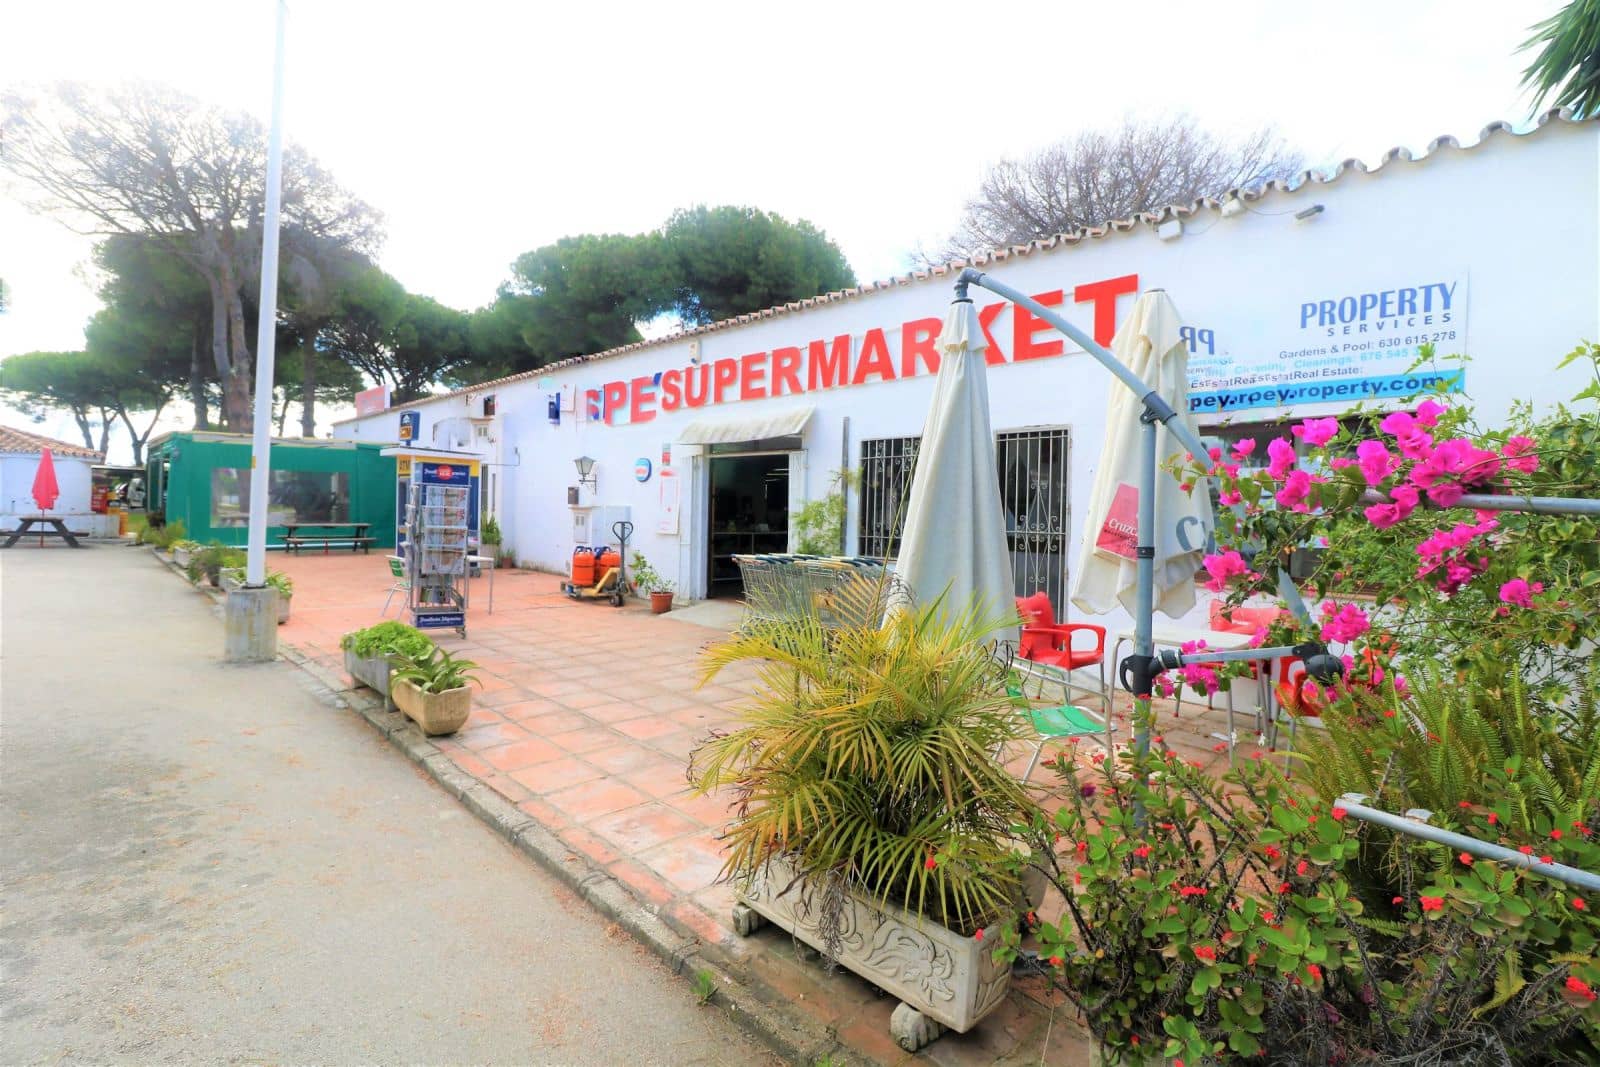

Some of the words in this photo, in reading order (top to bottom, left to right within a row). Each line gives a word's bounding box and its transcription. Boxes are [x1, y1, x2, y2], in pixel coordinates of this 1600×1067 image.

[1301, 281, 1457, 329] PROPERTY
[1327, 312, 1452, 337] SERVICES
[1279, 346, 1327, 360] Gardens
[1330, 344, 1339, 354] &
[1343, 341, 1375, 353] Pool:
[1378, 337, 1401, 349] 630
[1405, 333, 1428, 346] 615
[1432, 330, 1456, 343] 278
[1322, 364, 1363, 377] Estate:
